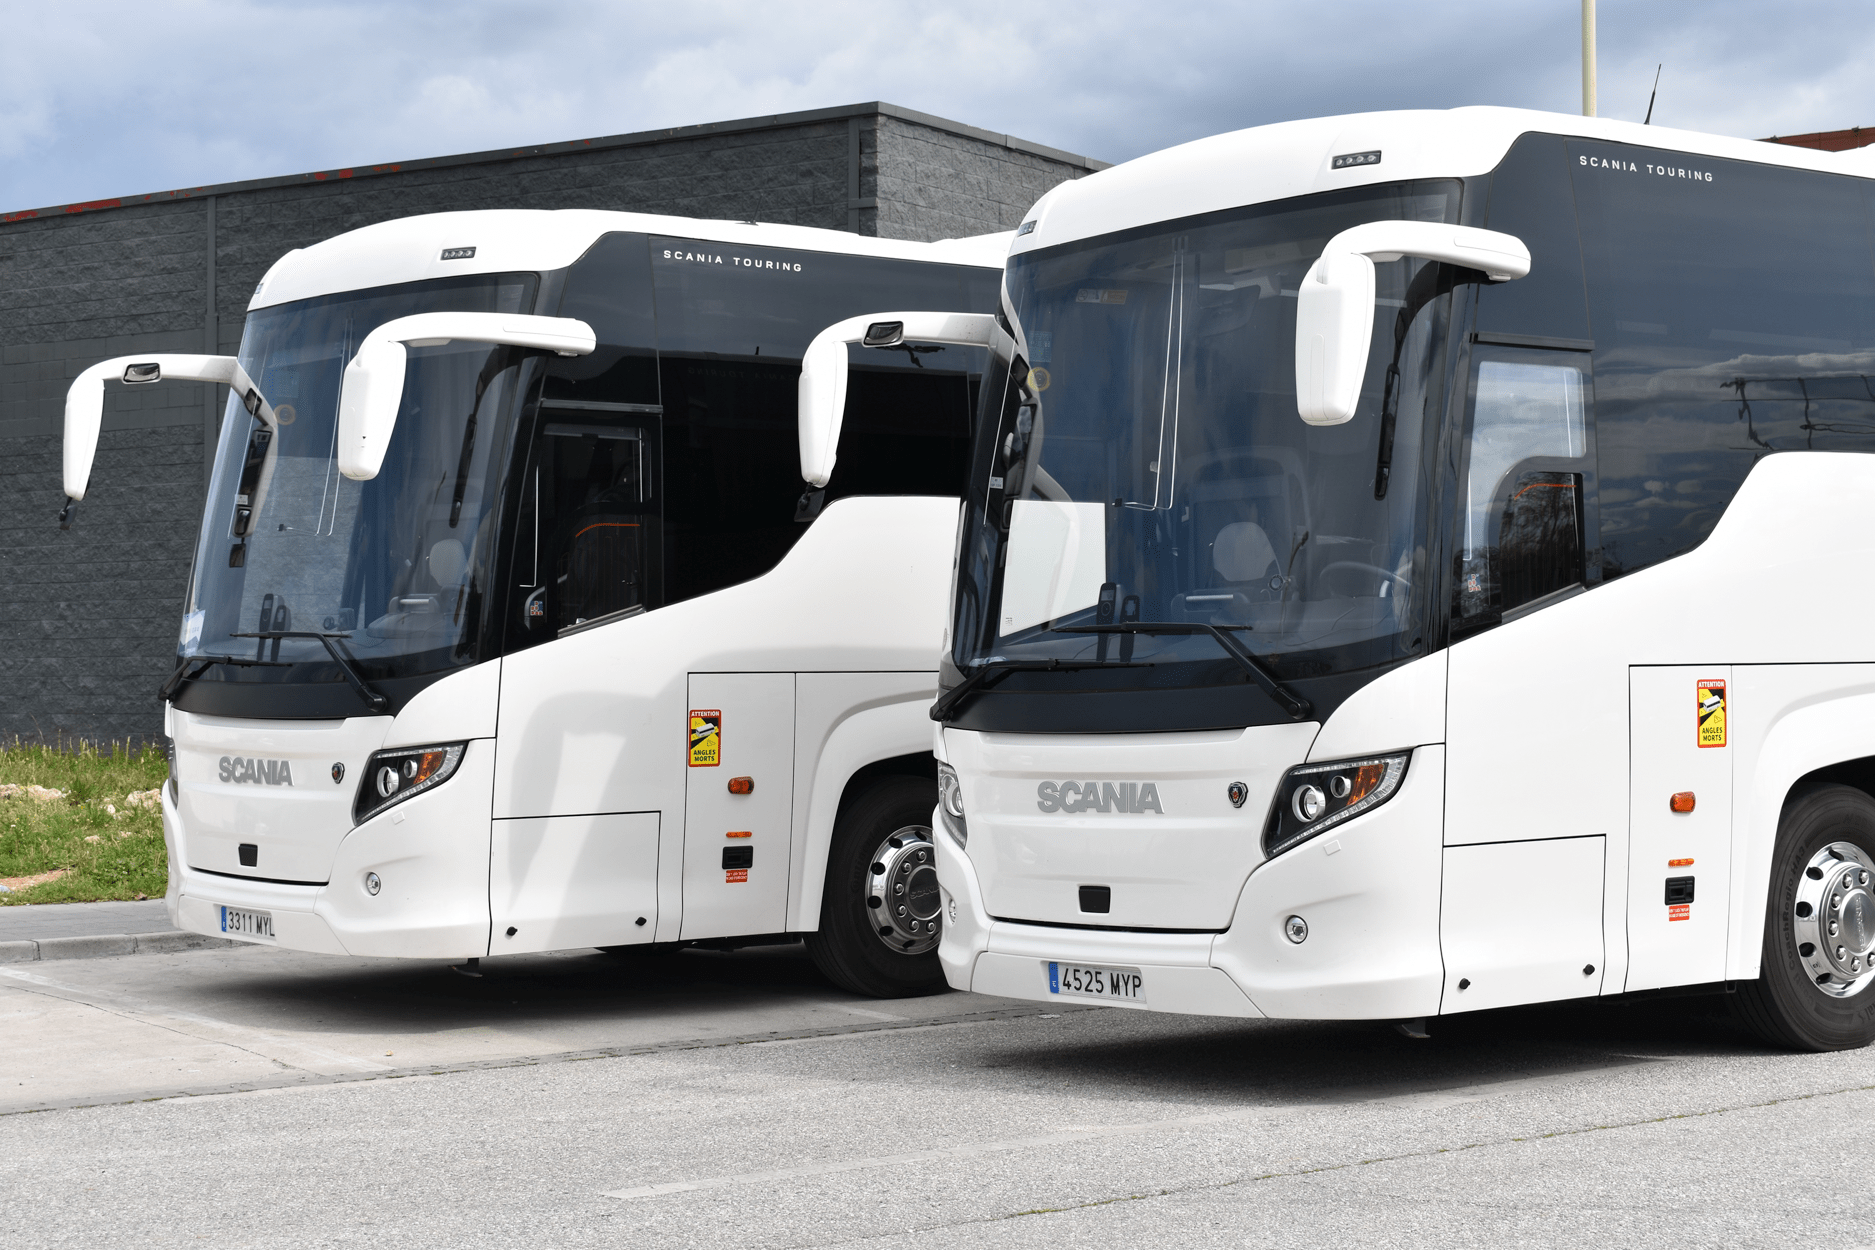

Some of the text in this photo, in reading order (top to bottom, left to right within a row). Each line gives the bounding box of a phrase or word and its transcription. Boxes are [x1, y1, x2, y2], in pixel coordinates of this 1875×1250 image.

[1579, 155, 1713, 182] SCANIA TOURING
[663, 250, 802, 272] SCANIA TOURING
[1702, 726, 1723, 734] ANGLES
[218, 756, 295, 787] SCANIA
[1037, 780, 1165, 814] SCANIA
[228, 911, 276, 937] 3311 MYL
[1062, 968, 1142, 998] 4525 MYP
